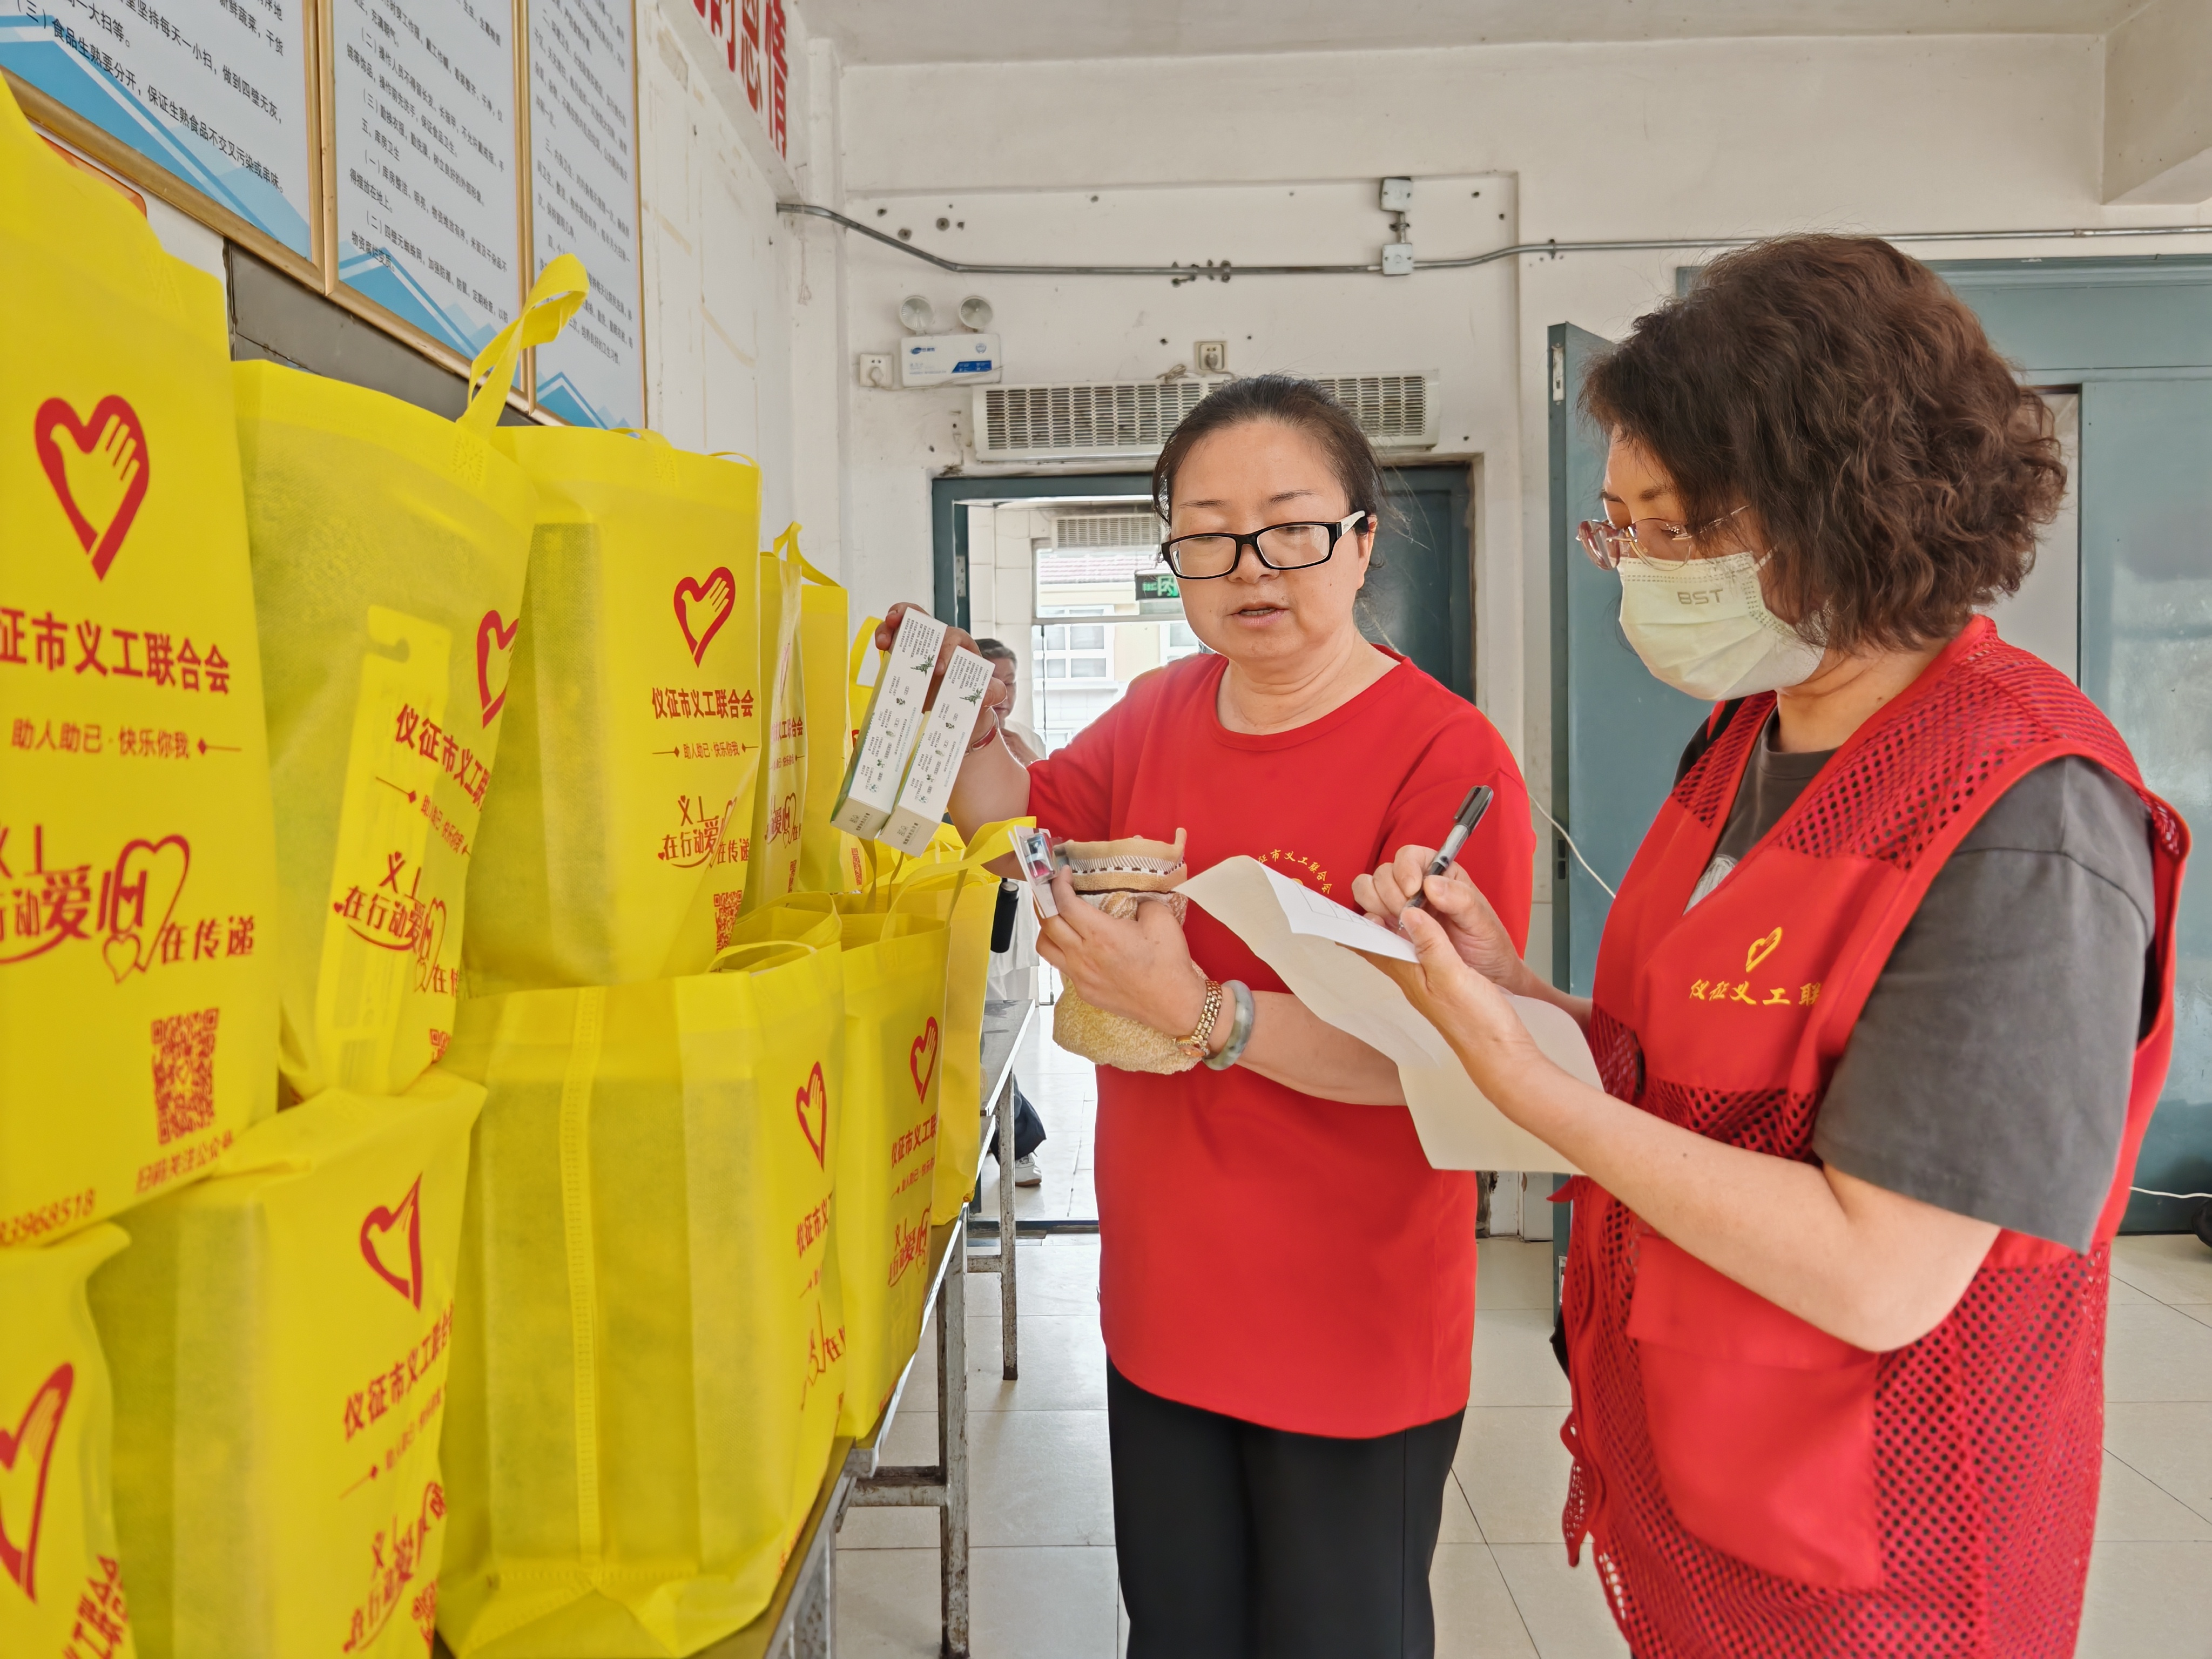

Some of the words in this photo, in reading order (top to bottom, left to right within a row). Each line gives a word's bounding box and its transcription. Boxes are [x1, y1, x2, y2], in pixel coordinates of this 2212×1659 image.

[1677, 588, 1723, 605] BST
[652, 687, 754, 719] 仪征市义工联合会
[797, 1190, 833, 1259] 仪征市义
